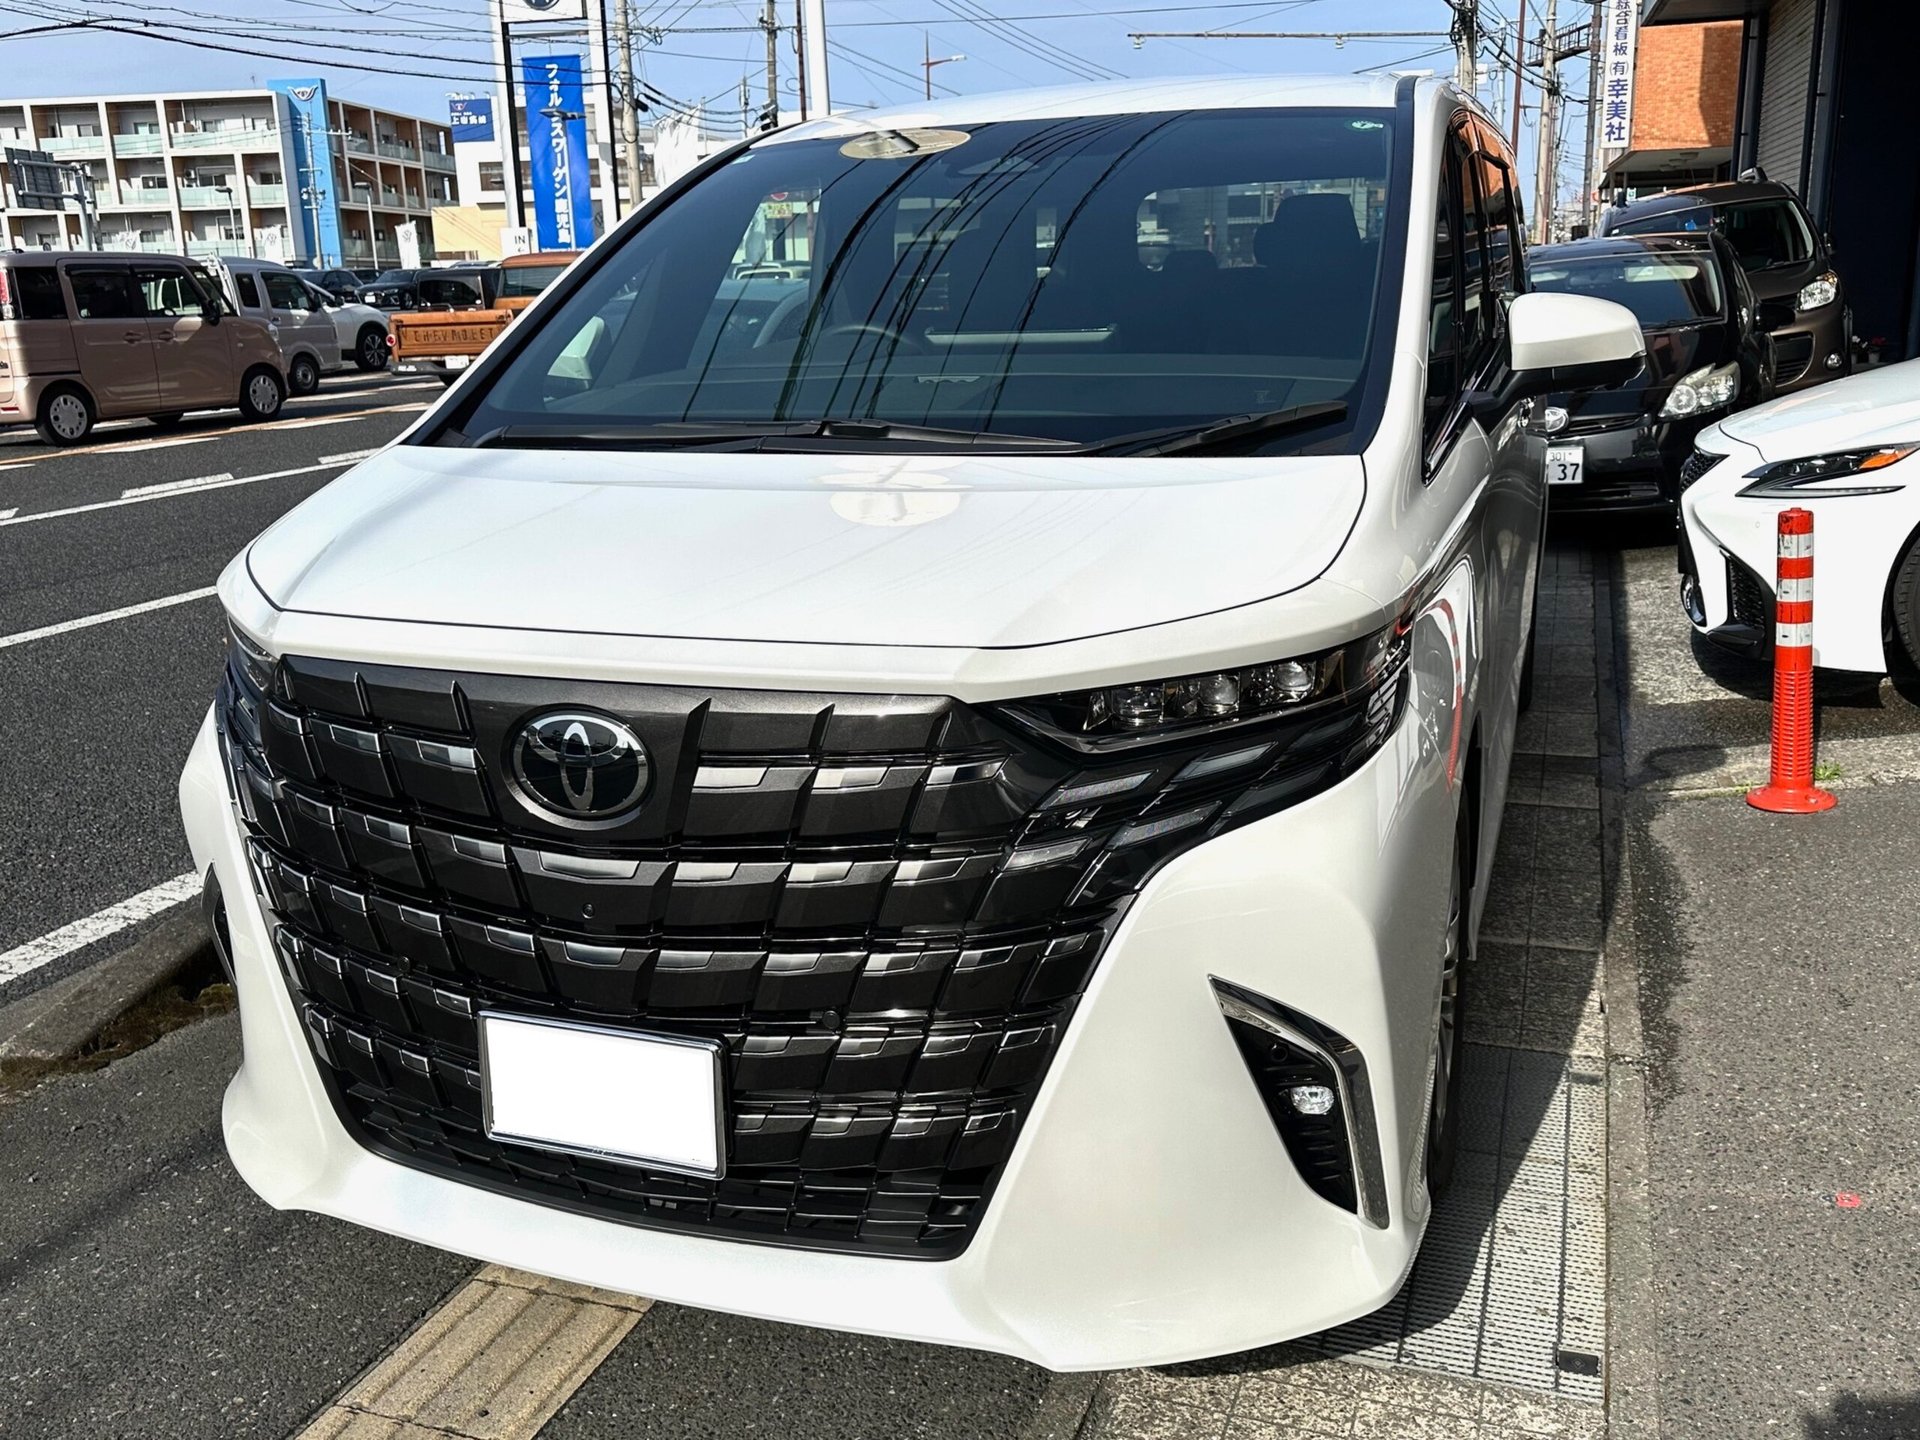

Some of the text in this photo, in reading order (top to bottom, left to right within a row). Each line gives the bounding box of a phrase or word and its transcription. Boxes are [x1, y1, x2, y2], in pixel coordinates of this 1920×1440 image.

[514, 235, 526, 244] IN
[414, 327, 494, 343] CHEVROLET
[1549, 451, 1567, 461] 301
[1557, 463, 1580, 481] 37
